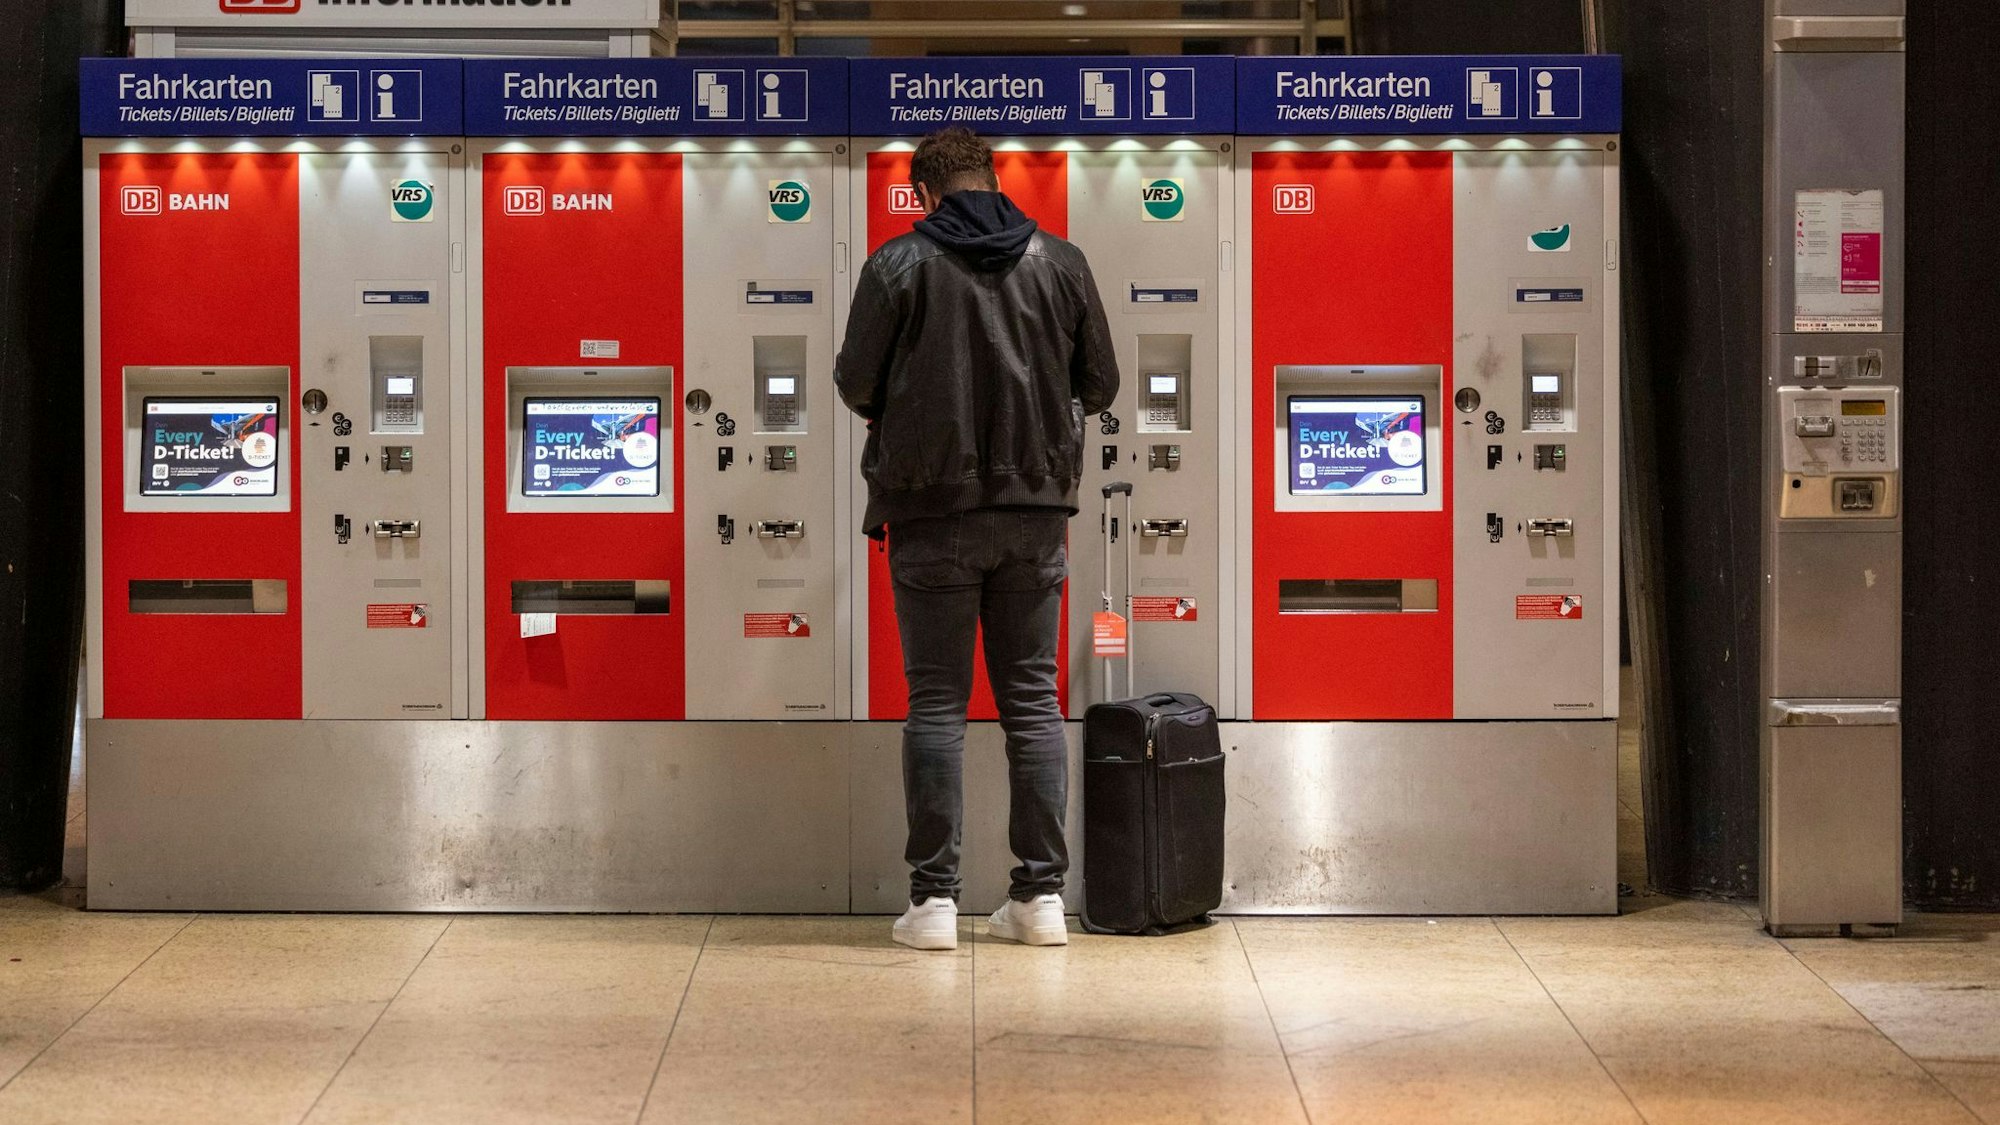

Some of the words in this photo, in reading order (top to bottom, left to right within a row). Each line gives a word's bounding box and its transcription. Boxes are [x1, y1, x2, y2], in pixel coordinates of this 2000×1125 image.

[119, 73, 272, 100] Fahrkarten
[504, 72, 657, 99] Fahrkarten
[890, 72, 1044, 99] Fahrkarten
[1276, 71, 1430, 98] Fahrkarten
[127, 188, 157, 211] DB
[169, 193, 229, 211] BAHN
[391, 188, 423, 202] VRS
[509, 188, 540, 211] DB
[551, 193, 613, 211] BAHN
[768, 189, 801, 203] VRS
[1142, 187, 1174, 201] VRS
[1278, 187, 1309, 210] DB
[154, 429, 204, 446] Every
[535, 429, 585, 447] Every
[1299, 428, 1348, 445] Every
[154, 444, 235, 460] D-Ticket!
[535, 445, 616, 460] D-Ticket!
[1299, 443, 1381, 459] D-Ticket!
